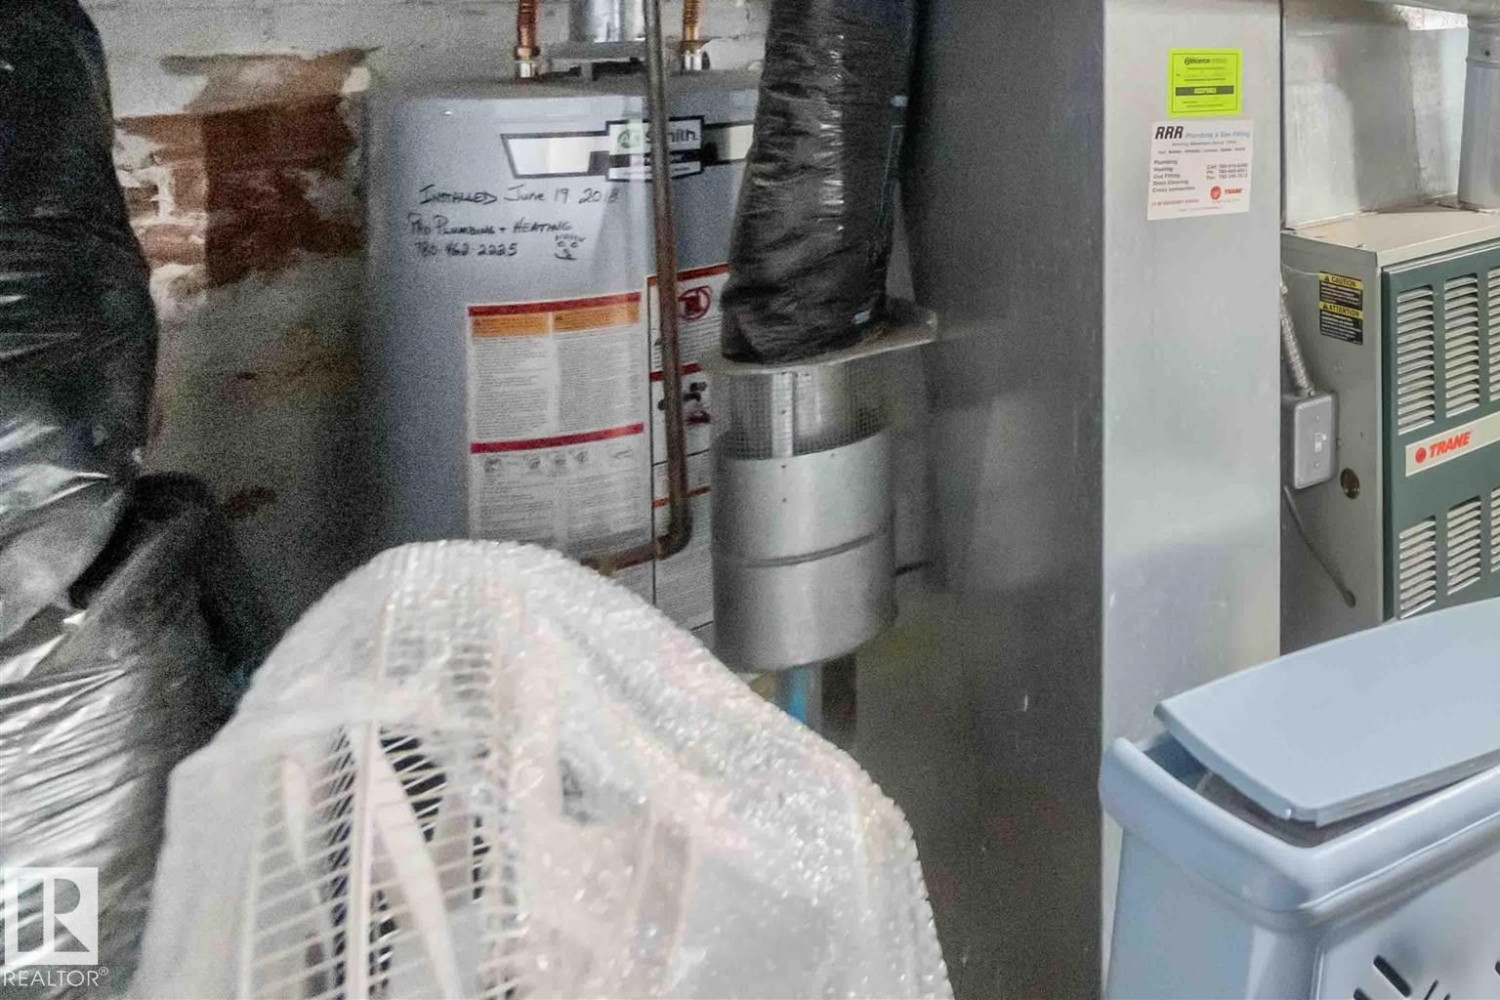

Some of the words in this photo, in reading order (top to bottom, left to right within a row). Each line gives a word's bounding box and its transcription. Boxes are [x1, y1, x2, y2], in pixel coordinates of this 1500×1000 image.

[1155, 126, 1184, 140] RRR
[503, 184, 545, 201] June
[554, 187, 570, 205] 19
[512, 217, 573, 234] HEATING
[1331, 276, 1357, 288] CAUTION
[1329, 304, 1360, 317] ATTENTION
[1429, 430, 1472, 459] TRANE
